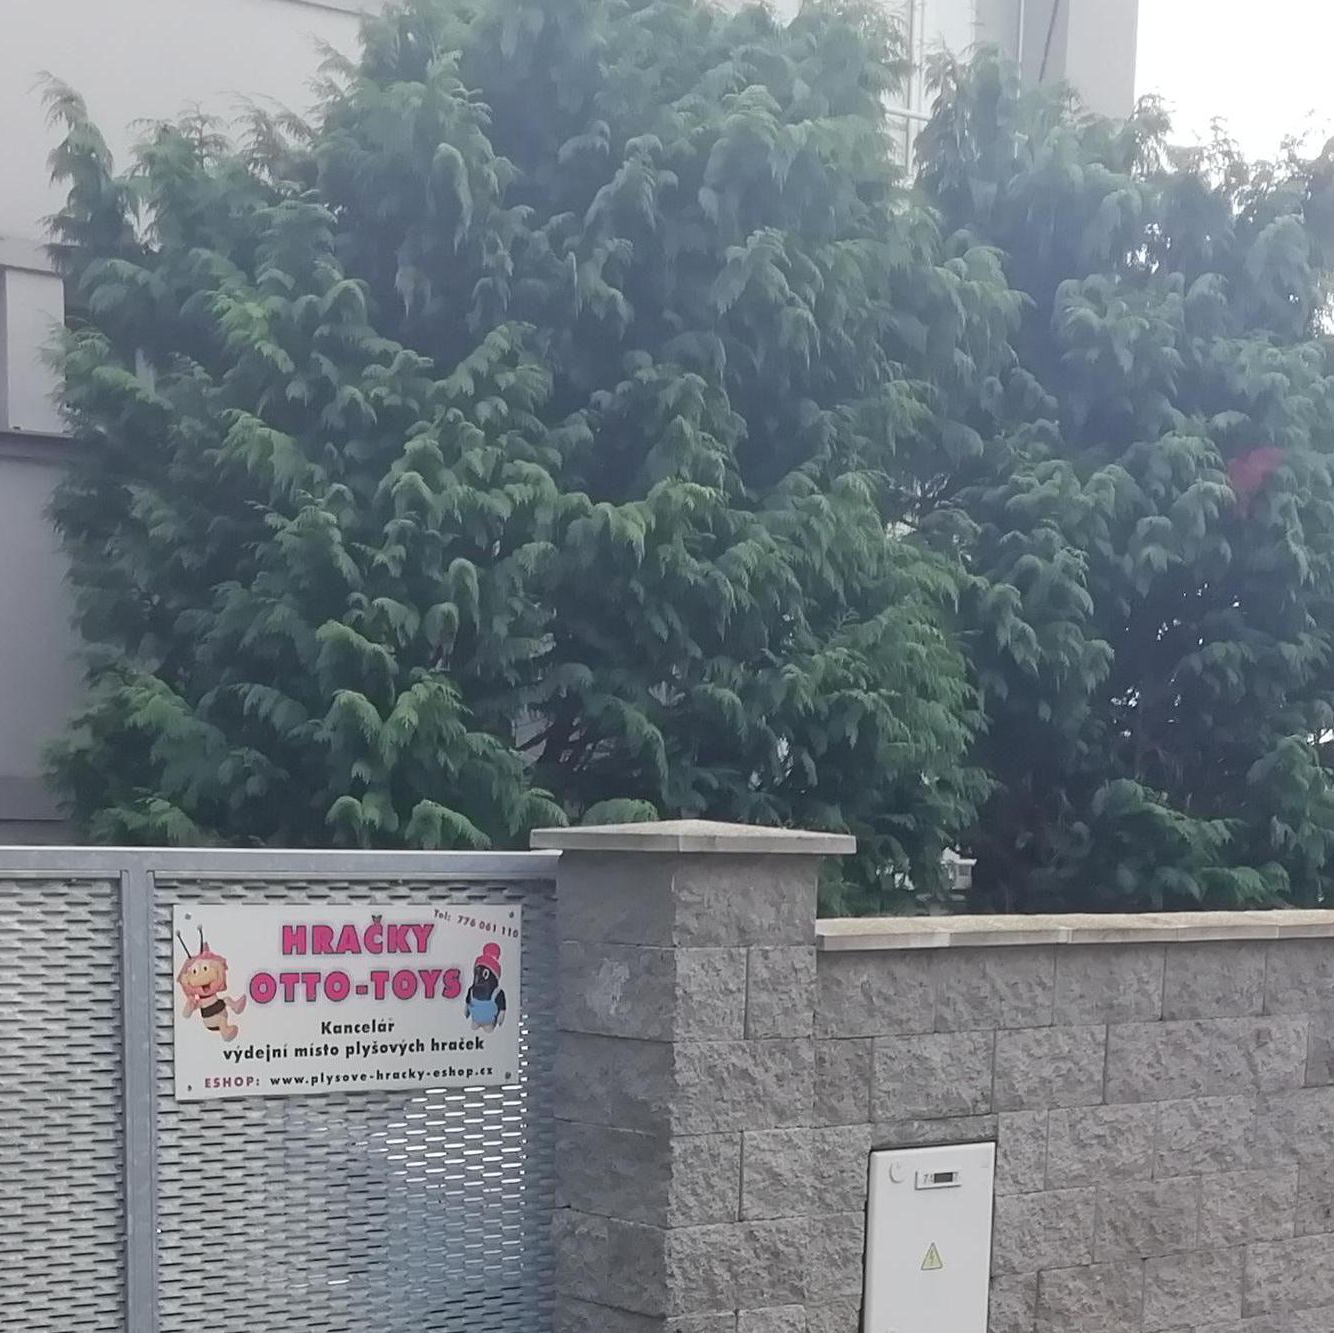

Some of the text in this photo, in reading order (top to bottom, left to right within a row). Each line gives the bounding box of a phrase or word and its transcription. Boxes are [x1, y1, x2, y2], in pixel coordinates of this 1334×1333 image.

[282, 914, 435, 956] HRAČKY
[433, 908, 520, 939] Tel: 776 061 110
[249, 968, 462, 1004] OTTO-TOYS
[320, 1016, 396, 1036] Kancelář
[223, 1035, 485, 1063] výdejní místo plyšových hraček
[204, 1065, 494, 1089] ESHOP: www.plysove-hracky-eshop.cz
